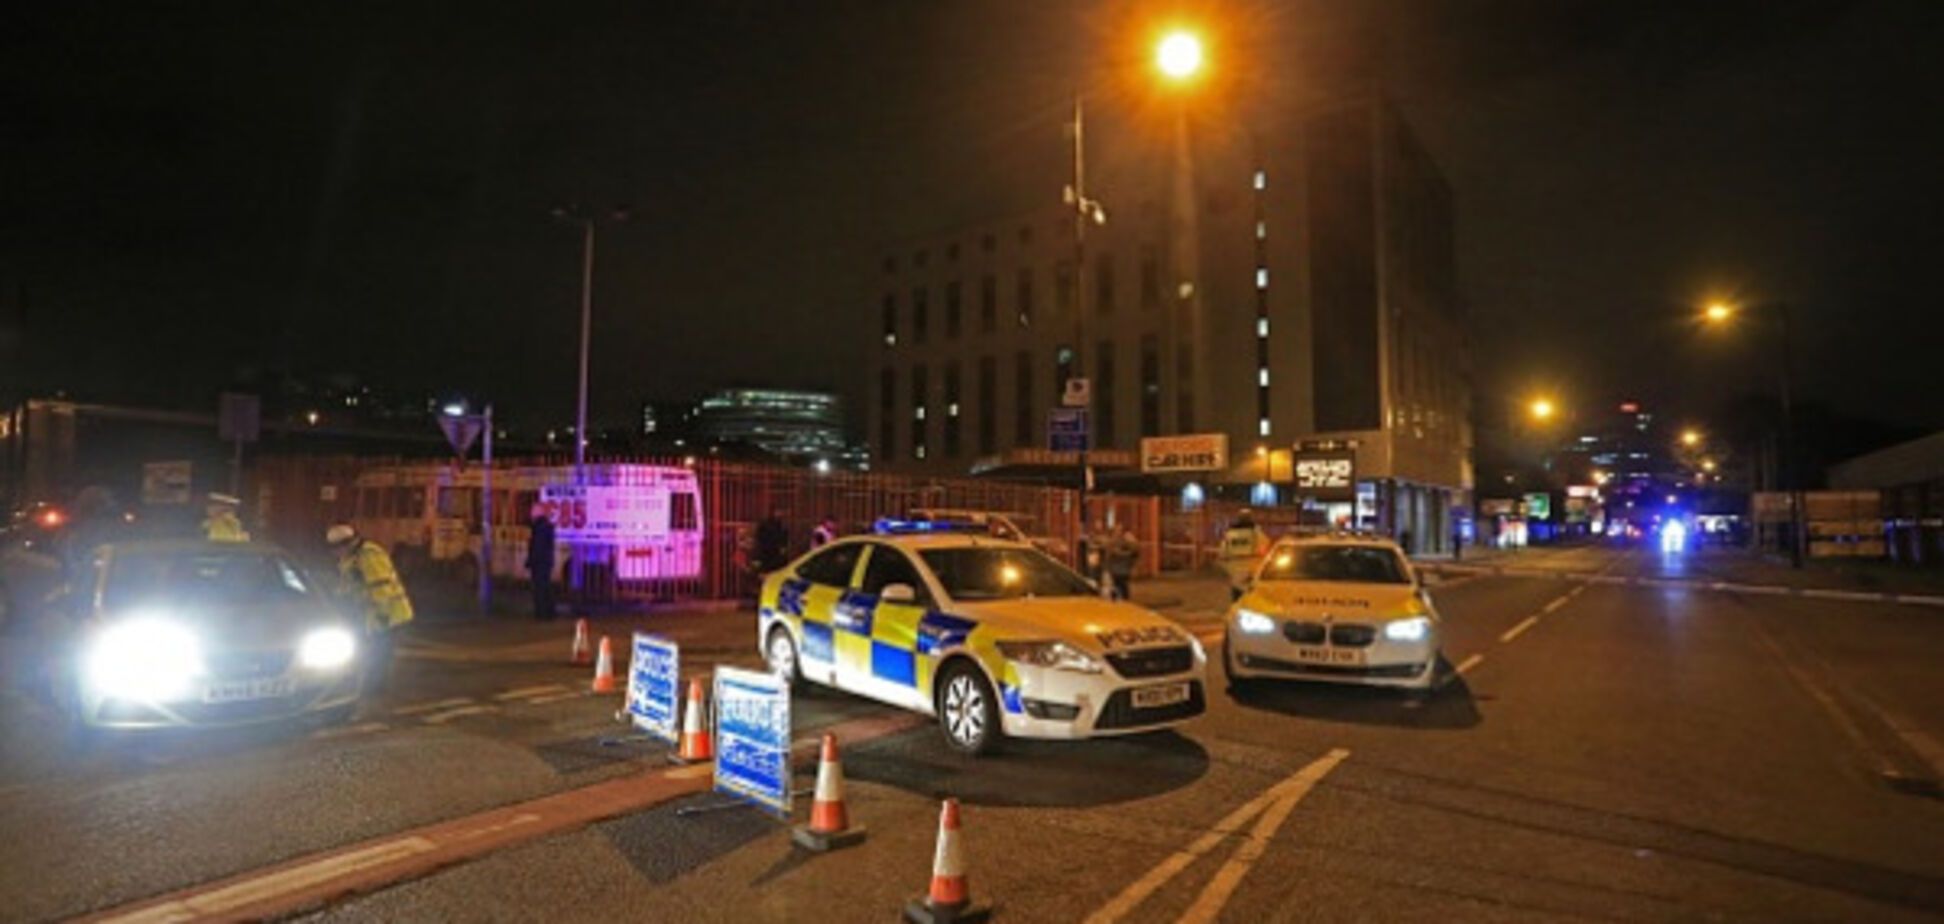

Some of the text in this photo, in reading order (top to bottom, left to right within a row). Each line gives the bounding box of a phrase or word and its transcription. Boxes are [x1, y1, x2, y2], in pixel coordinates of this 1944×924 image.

[1147, 452, 1216, 468] CAR HIRE
[1095, 625, 1182, 649] POLICE
